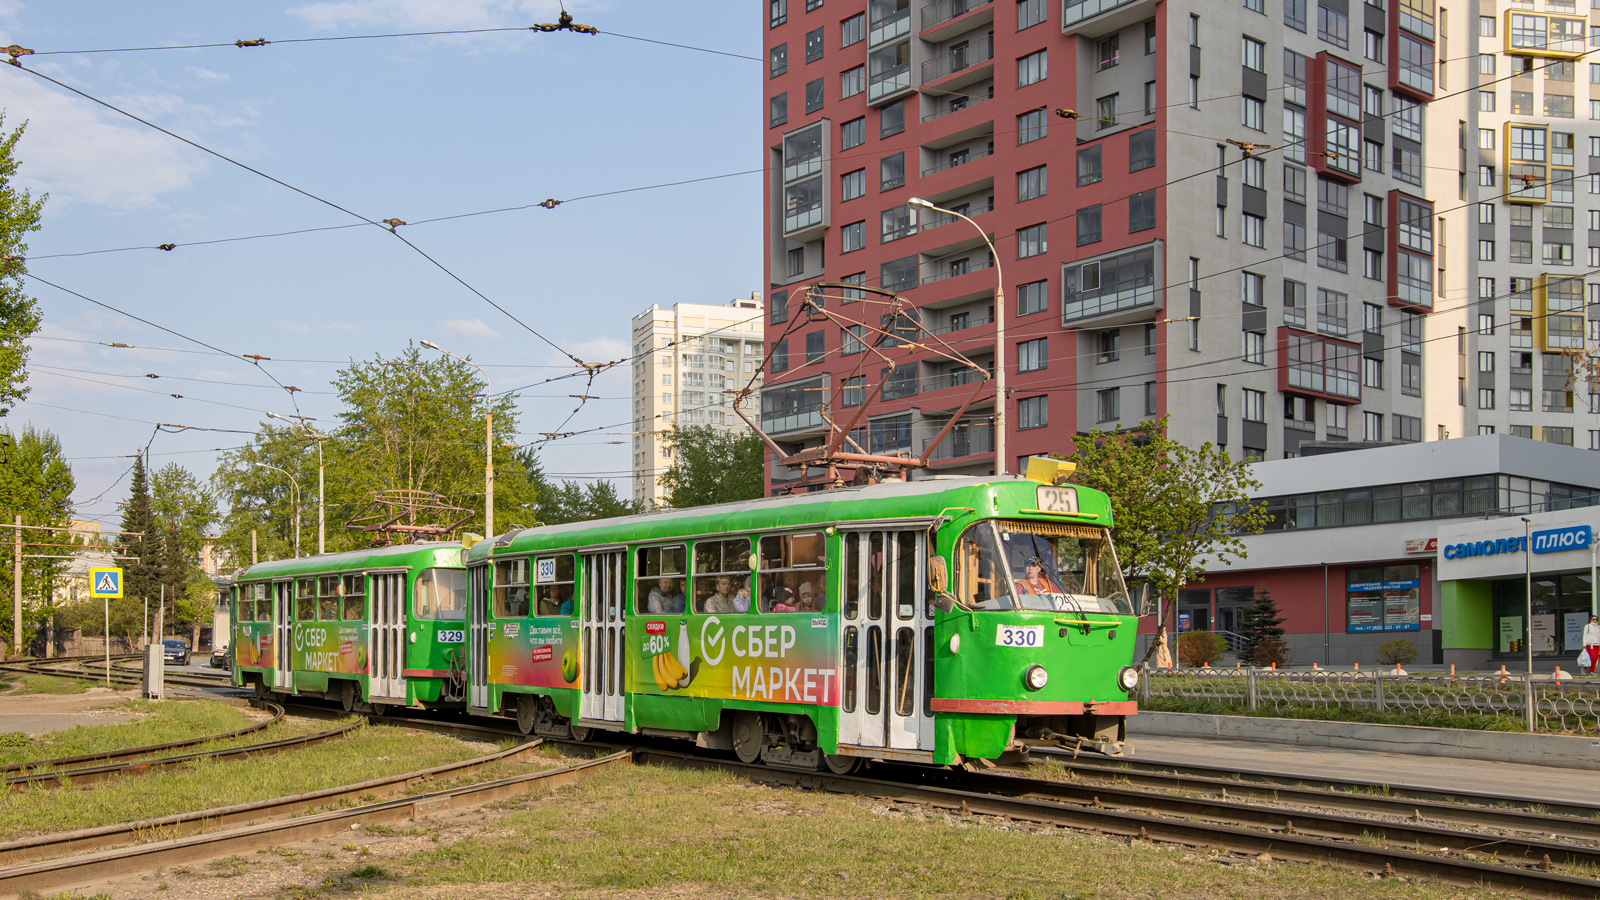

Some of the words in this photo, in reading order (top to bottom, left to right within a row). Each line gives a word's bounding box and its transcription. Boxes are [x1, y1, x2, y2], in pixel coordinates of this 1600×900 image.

[1045, 490, 1071, 511] 25
[540, 561, 554, 576] 330
[529, 625, 552, 636] Доставим
[811, 619, 827, 627] ВЫХОД
[304, 627, 326, 646] СБЕР
[440, 631, 462, 642] 329
[529, 637, 538, 645] что
[538, 637, 544, 645] вы
[545, 635, 563, 645] любите
[642, 643, 650, 652] до
[650, 634, 670, 654] 60%
[731, 625, 796, 658] СБЕР
[1003, 629, 1036, 646] 330
[305, 652, 338, 672] МАРКЕТ
[732, 665, 836, 703] МАРКЕТ
